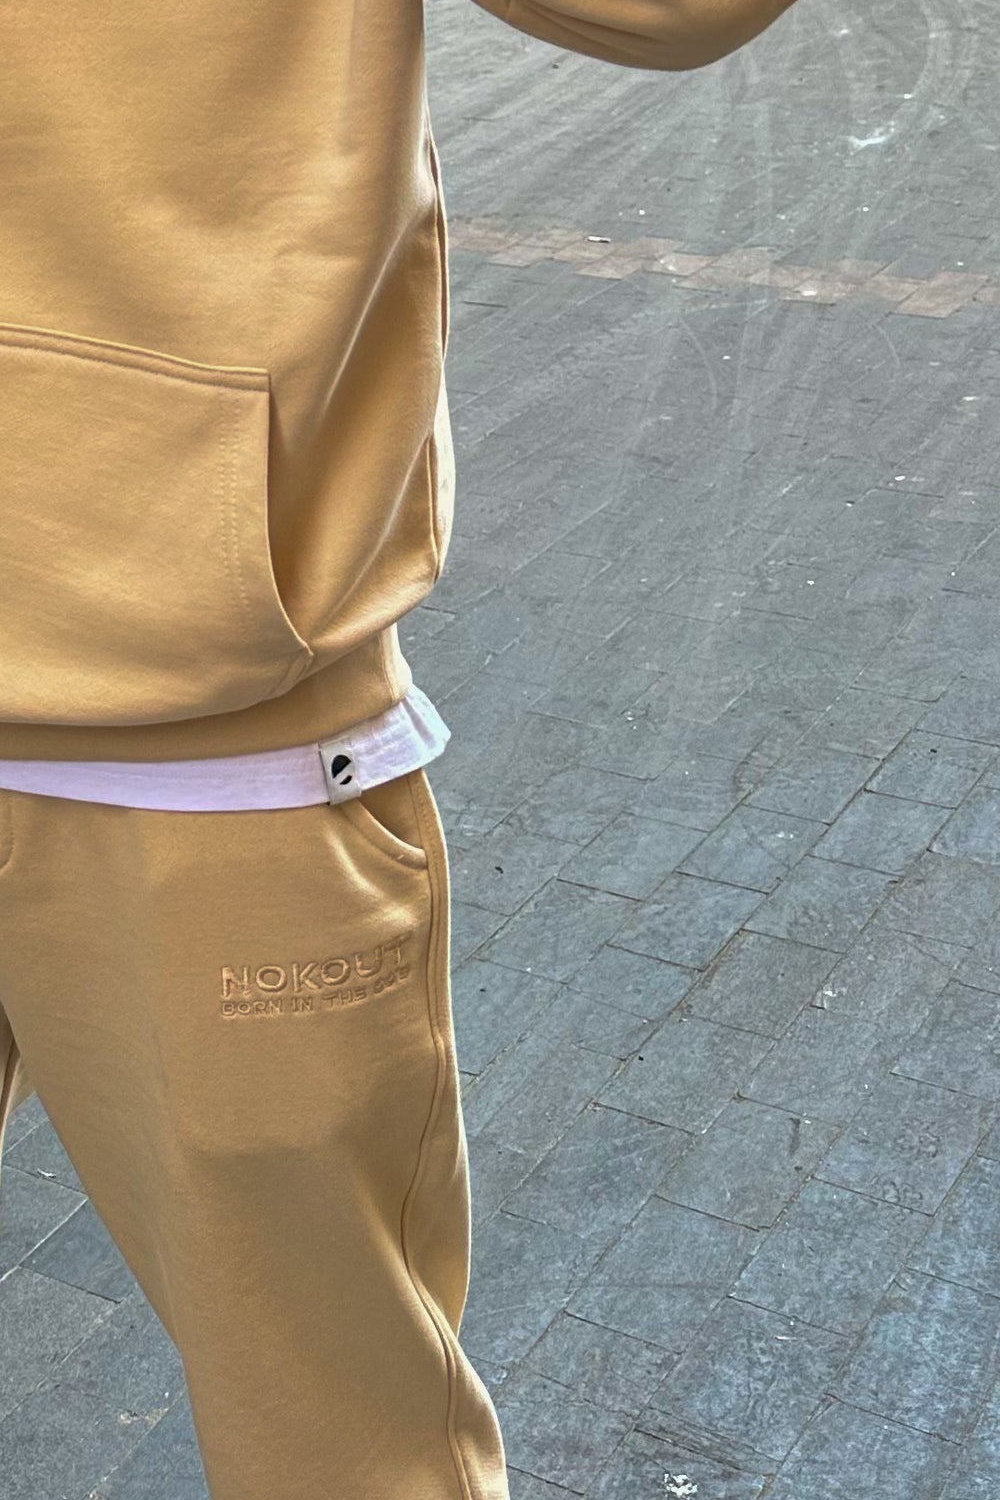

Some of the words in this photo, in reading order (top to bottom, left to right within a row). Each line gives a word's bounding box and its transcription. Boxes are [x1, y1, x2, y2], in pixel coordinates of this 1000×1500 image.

[221, 932, 412, 997] NOKOUT
[221, 1000, 283, 1017] BORN
[292, 997, 314, 1013] IN
[322, 987, 368, 1008] THE
